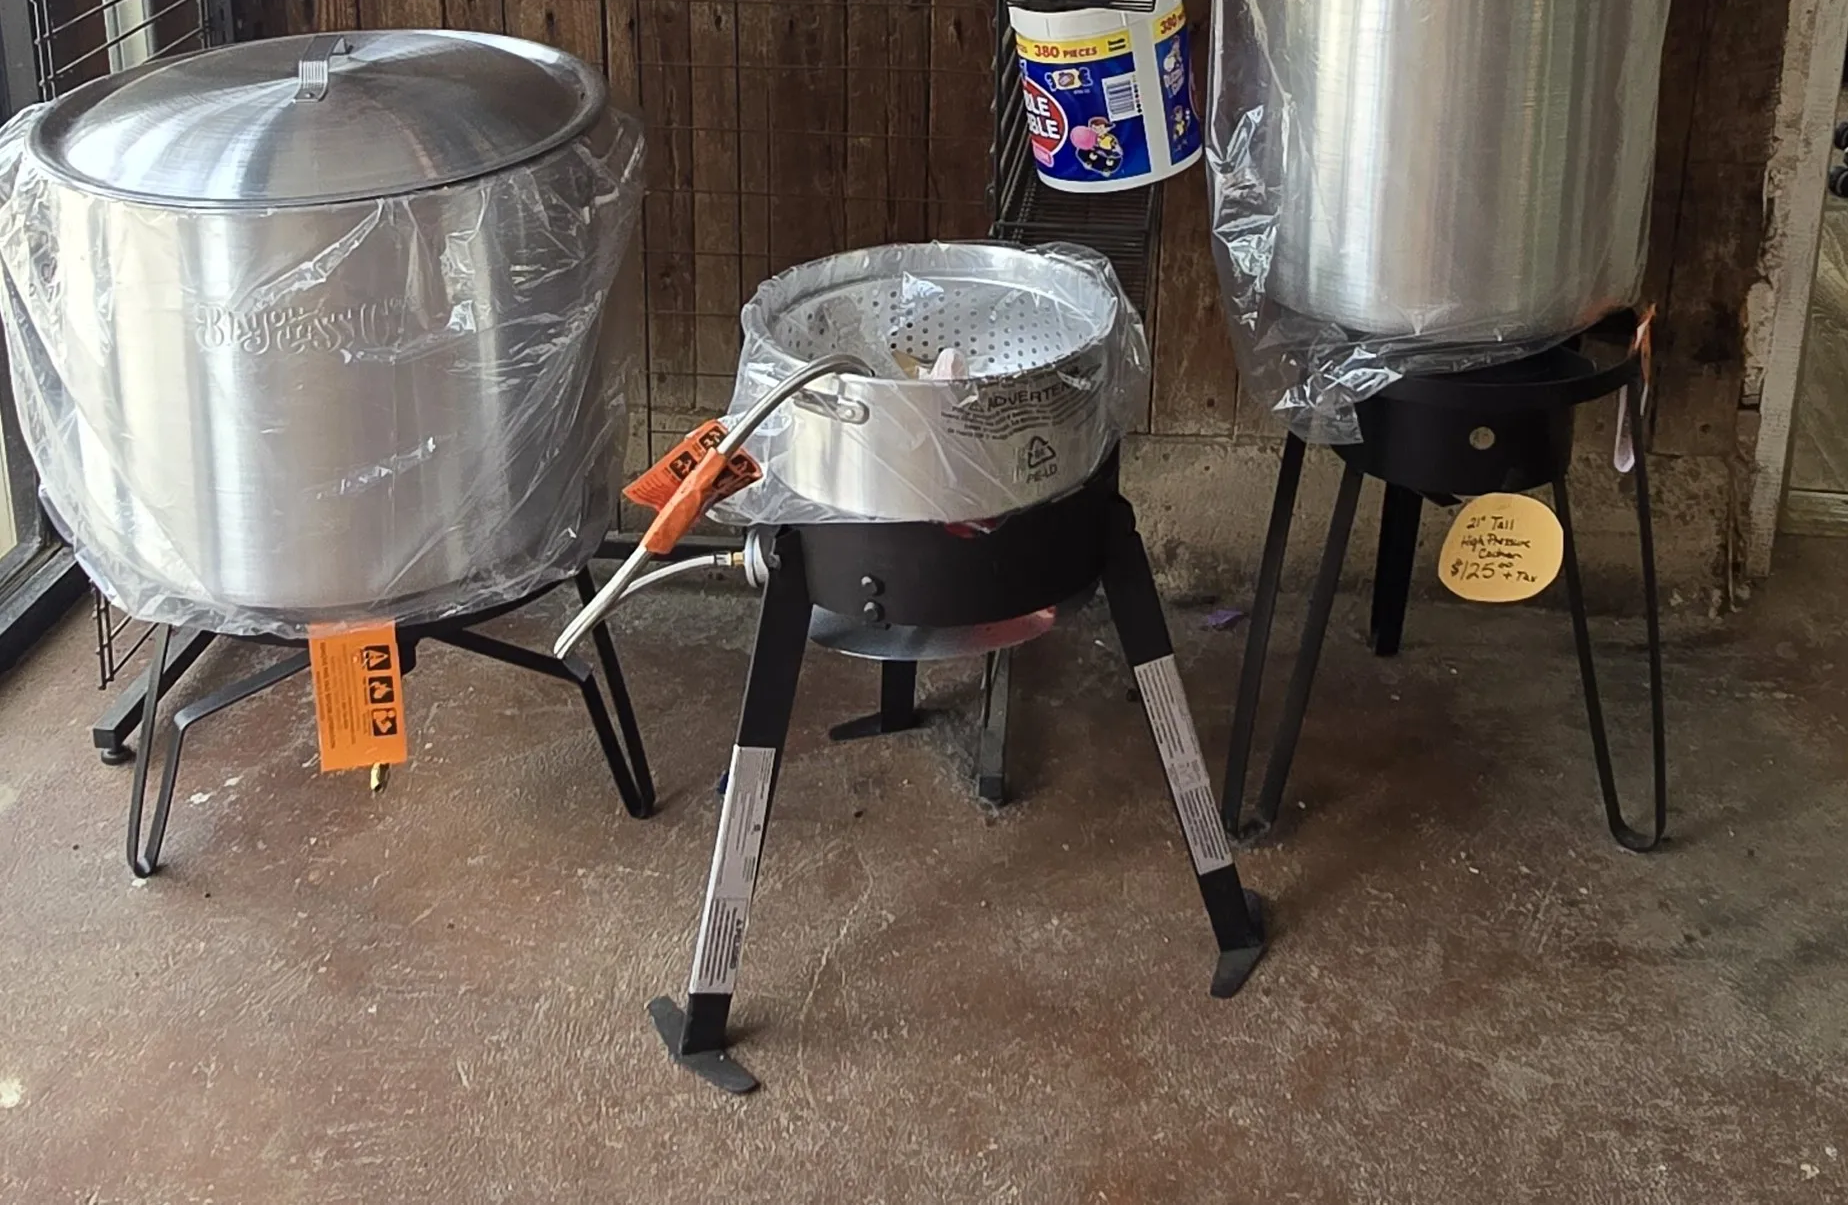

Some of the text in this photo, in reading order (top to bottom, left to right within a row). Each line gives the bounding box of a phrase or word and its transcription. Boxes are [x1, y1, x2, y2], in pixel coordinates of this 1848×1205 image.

[1034, 44, 1098, 59] 380 PIECES
[1491, 516, 1515, 531] Tall
[1461, 535, 1485, 552] High
[1517, 570, 1538, 583] Tax
